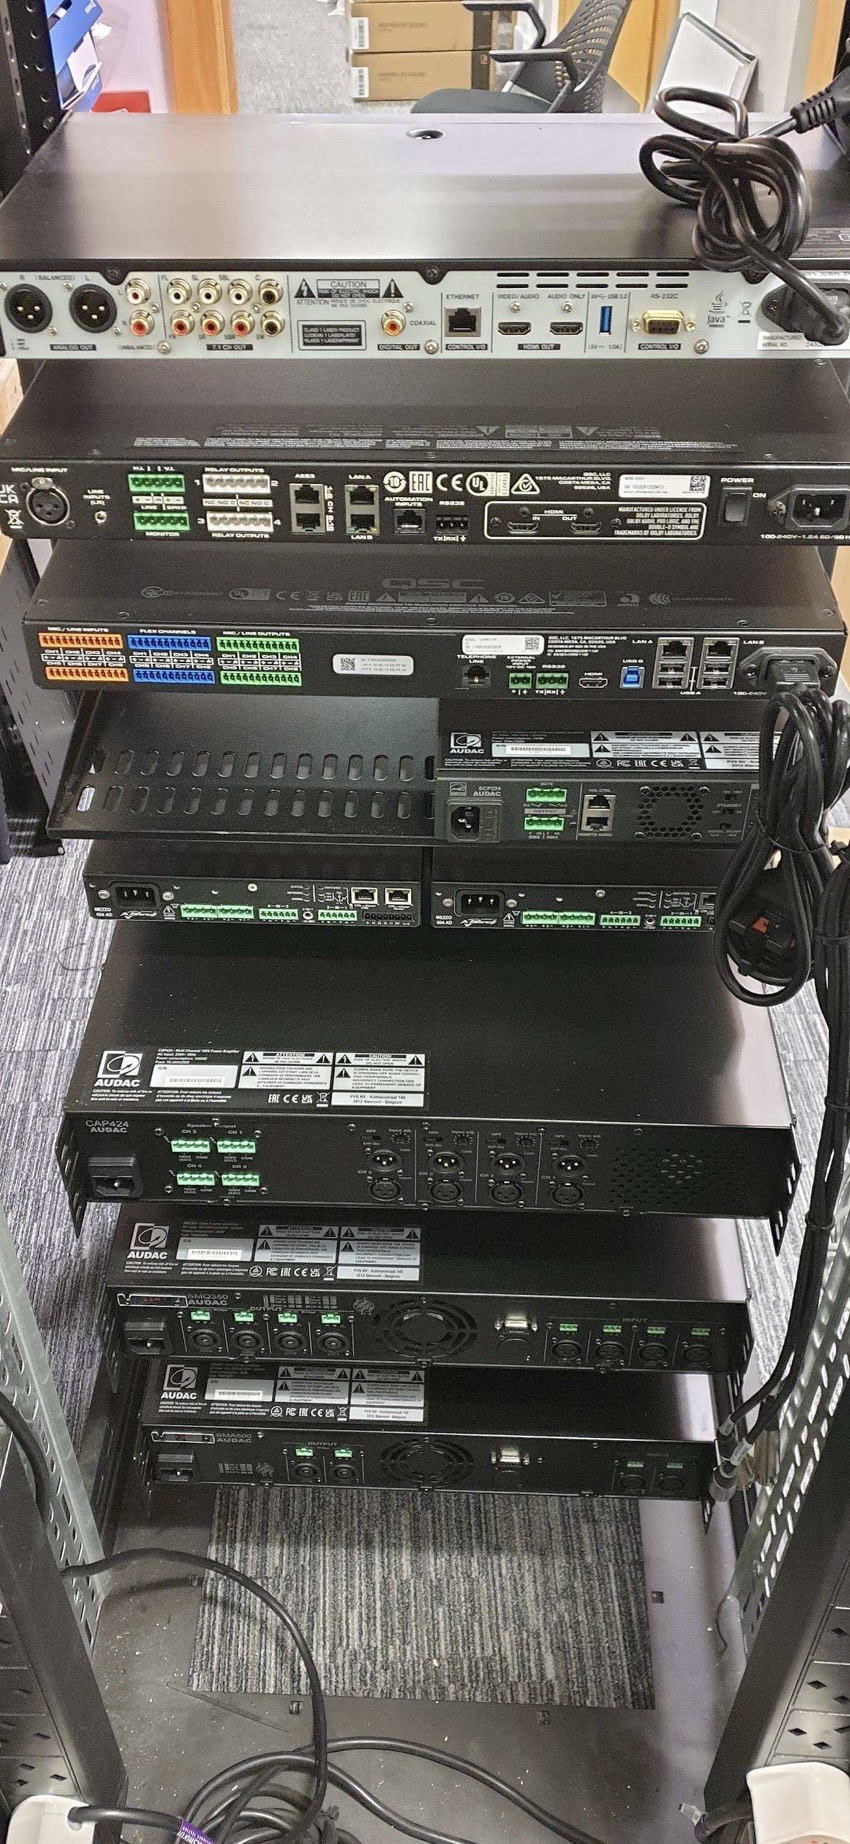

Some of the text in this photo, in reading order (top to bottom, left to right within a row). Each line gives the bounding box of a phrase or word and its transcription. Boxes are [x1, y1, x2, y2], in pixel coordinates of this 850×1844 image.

[707, 315, 726, 324] Java
[390, 477, 399, 487] 10
[382, 578, 487, 589] QSC
[94, 1079, 141, 1087] AUDAC
[127, 1252, 168, 1260] AUDAC
[161, 1392, 198, 1400] AUDAC
